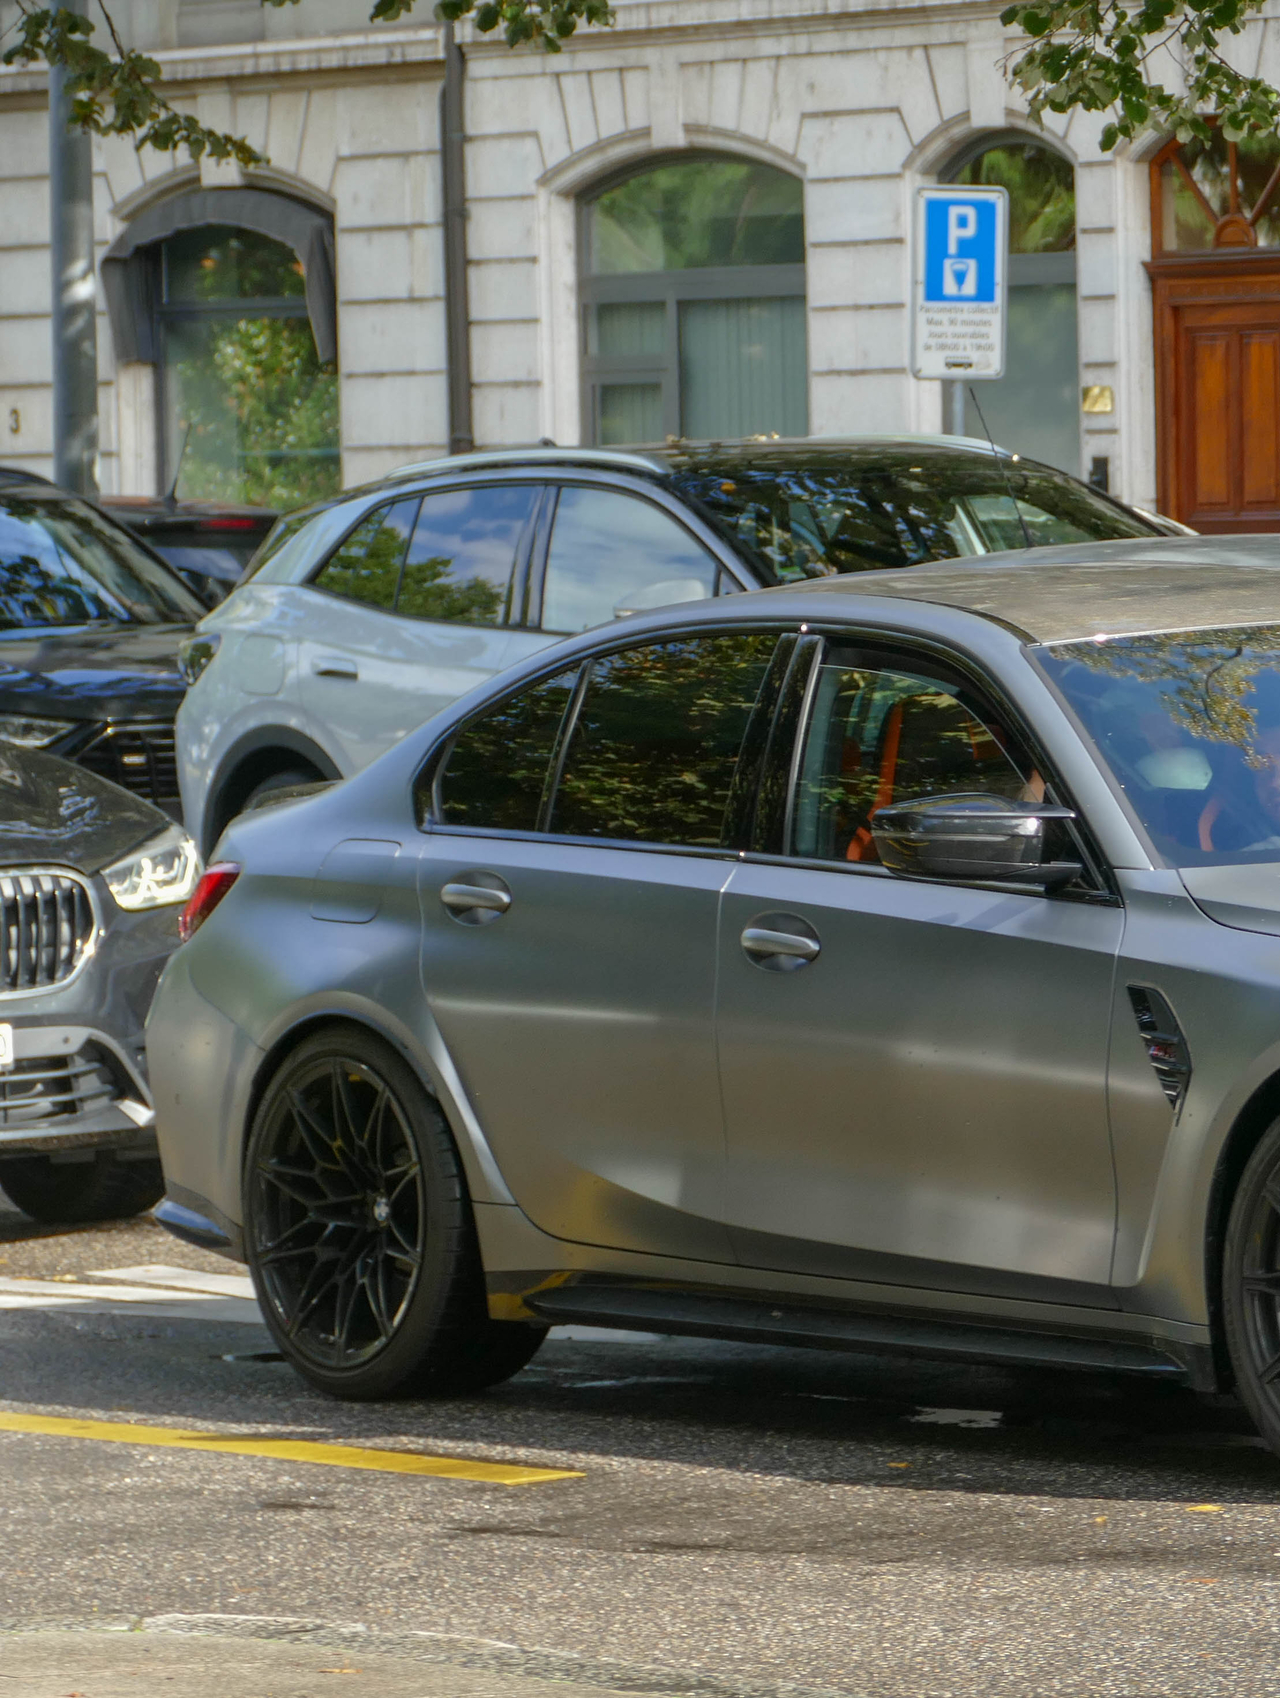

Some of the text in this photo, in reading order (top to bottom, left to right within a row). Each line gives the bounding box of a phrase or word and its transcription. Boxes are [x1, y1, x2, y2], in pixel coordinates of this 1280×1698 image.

[947, 205, 977, 256] P
[961, 318, 993, 327] minutes
[10, 408, 21, 434] 3
